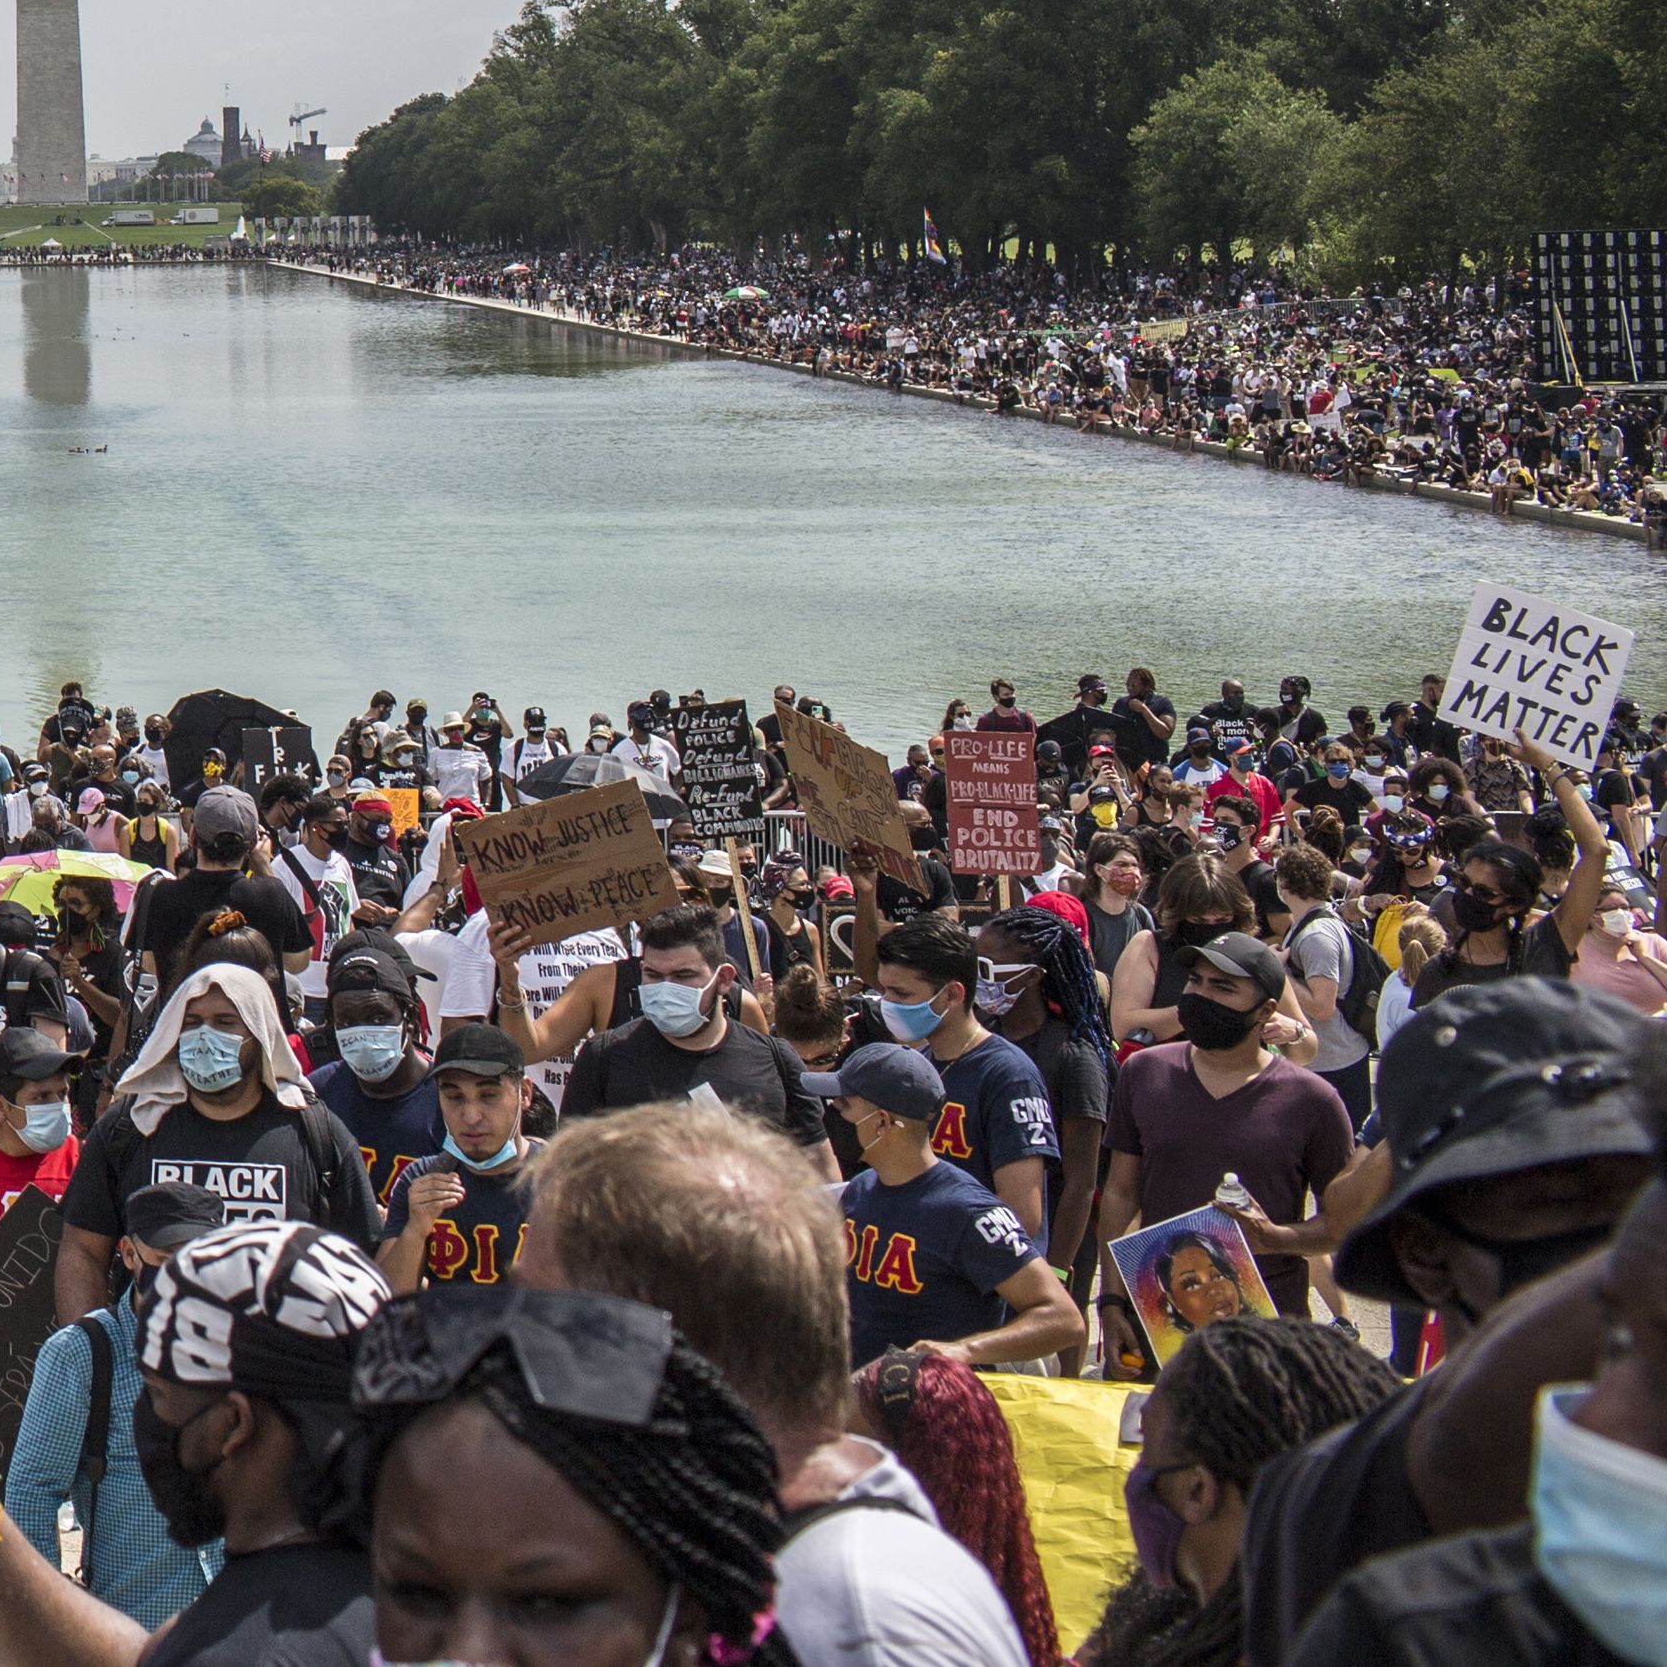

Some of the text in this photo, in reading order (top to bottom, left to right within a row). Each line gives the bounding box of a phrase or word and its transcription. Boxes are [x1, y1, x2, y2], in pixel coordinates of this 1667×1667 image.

[1481, 597, 1619, 675] BLACK
[1470, 642, 1602, 706] LIVES
[677, 708, 743, 730] Defund
[1216, 719, 1244, 728] Black
[1449, 679, 1599, 760] MATTER
[685, 730, 737, 747] POLICE
[951, 738, 1028, 759] PRO-LIFE
[683, 745, 750, 766] Defund
[683, 762, 757, 784] BILLIONAIRES
[972, 762, 1010, 775] MEANS
[951, 780, 1038, 801] PRO-BLACK-LIFE
[691, 807, 745, 823] BLACK
[973, 808, 1019, 828] END
[472, 803, 634, 873] KNOW JUSTICE
[957, 827, 1037, 848] POLICE
[955, 848, 1041, 871] BRUTALITY
[501, 867, 660, 933] KNOW PEACE
[533, 942, 552, 956] Will
[553, 941, 576, 956] Wipe
[577, 943, 601, 959] Every
[537, 963, 562, 978] From
[526, 989, 541, 1002] ere
[544, 1069, 562, 1085] Has
[1009, 1097, 1052, 1124] GMU
[157, 1166, 280, 1202] BLACK
[975, 1206, 1021, 1245] GMU
